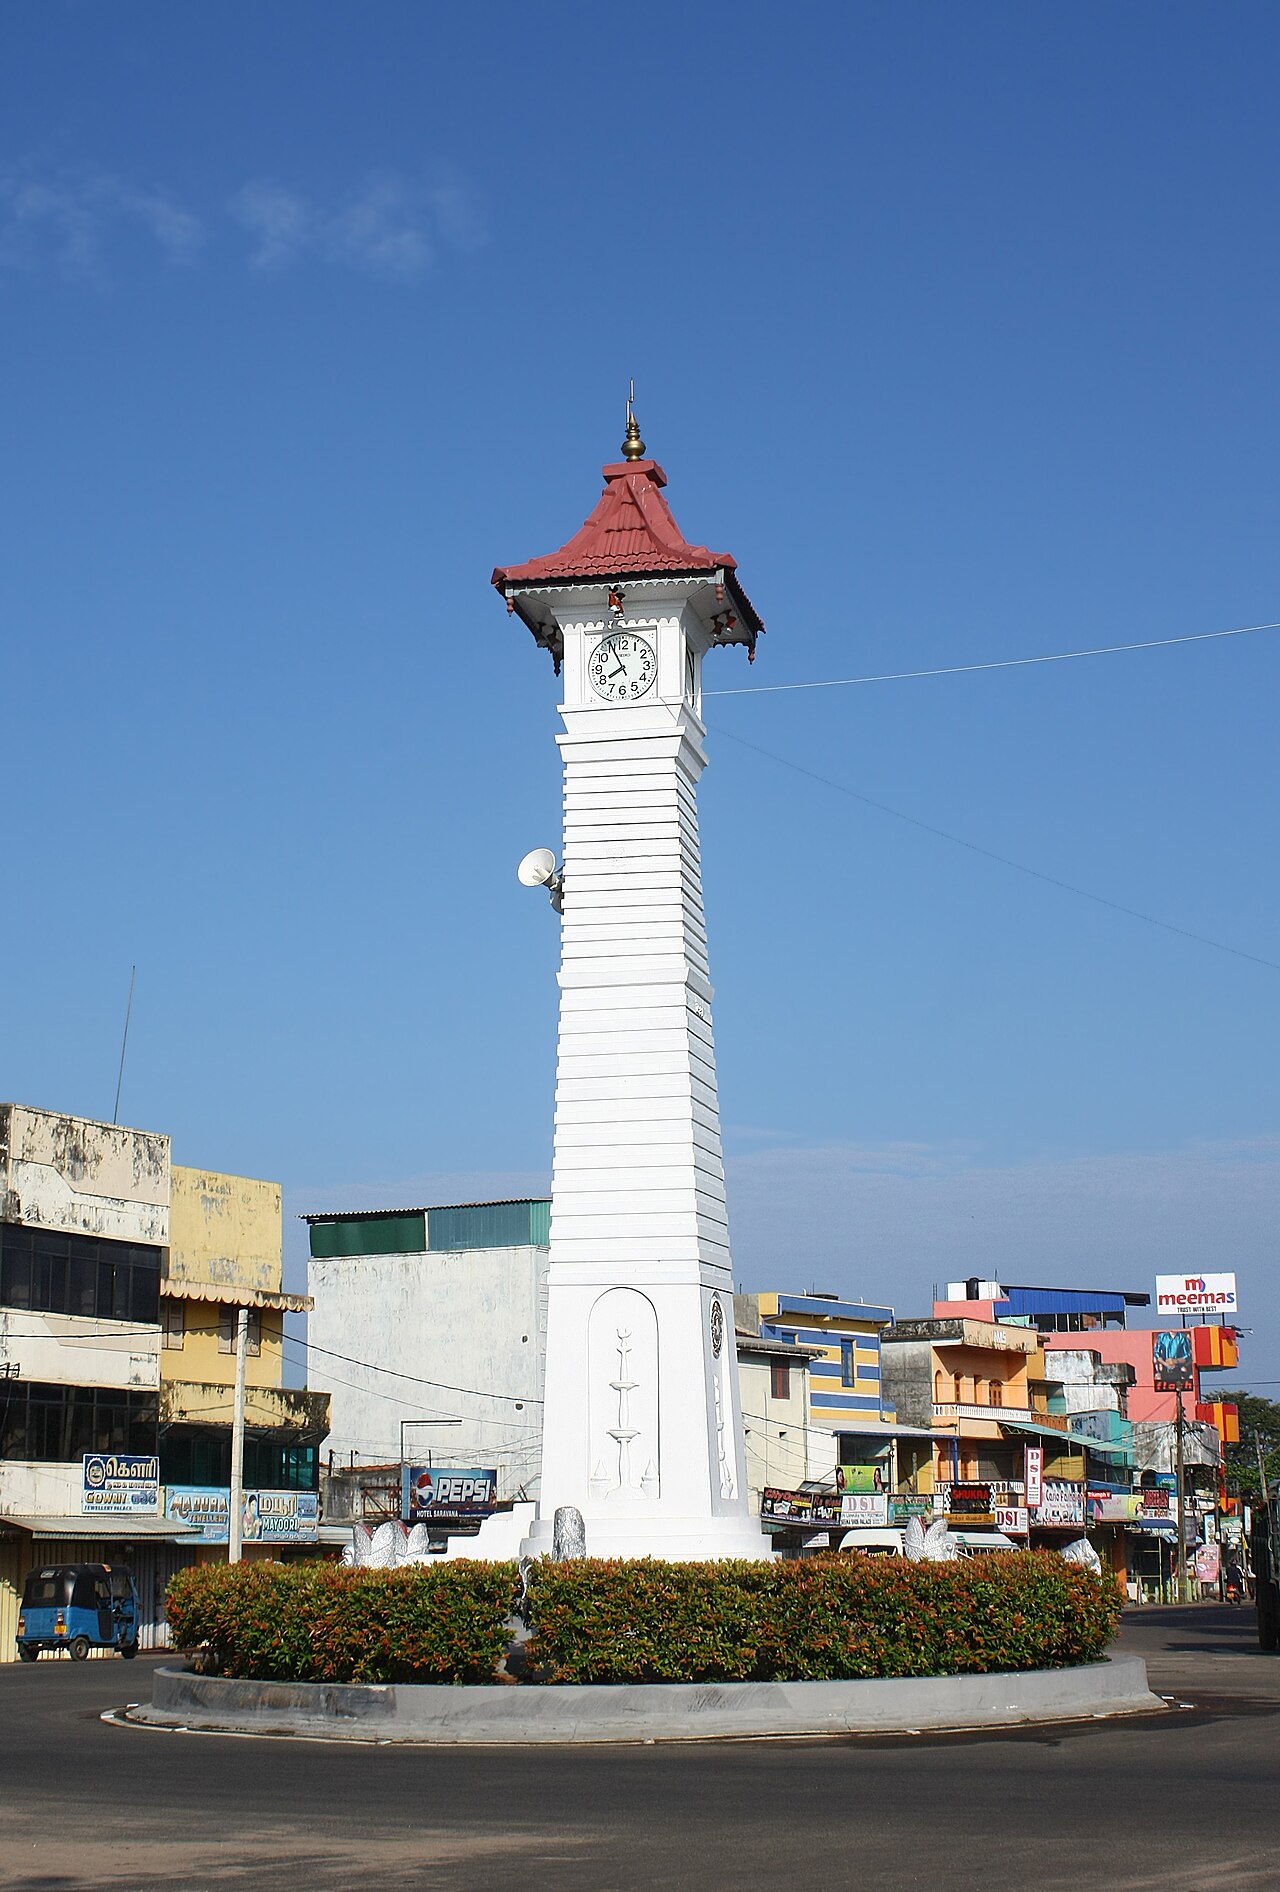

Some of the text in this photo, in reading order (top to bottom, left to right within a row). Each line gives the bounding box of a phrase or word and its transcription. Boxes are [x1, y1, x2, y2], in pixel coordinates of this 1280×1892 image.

[618, 640, 629, 650] 12
[634, 642, 637, 651] 1
[598, 653, 608, 663] 10
[640, 649, 647, 659] 2
[595, 665, 603, 675] 9
[643, 661, 650, 671] 3
[599, 675, 607, 685] 8
[639, 673, 646, 682] 4
[608, 684, 615, 693] 7
[619, 686, 627, 695] 6
[630, 682, 638, 691] 5
[1159, 1292, 1235, 1305] meemas
[1157, 1381, 1192, 1390] flah
[1030, 1452, 1040, 1485] DSI
[436, 1477, 492, 1503] PEPSI
[952, 1489, 989, 1500] SHUKRA
[848, 1497, 876, 1511] DSI
[416, 1510, 432, 1518] HOTEL
[433, 1510, 458, 1518] SARAVANA
[995, 1511, 1019, 1527] DSI
